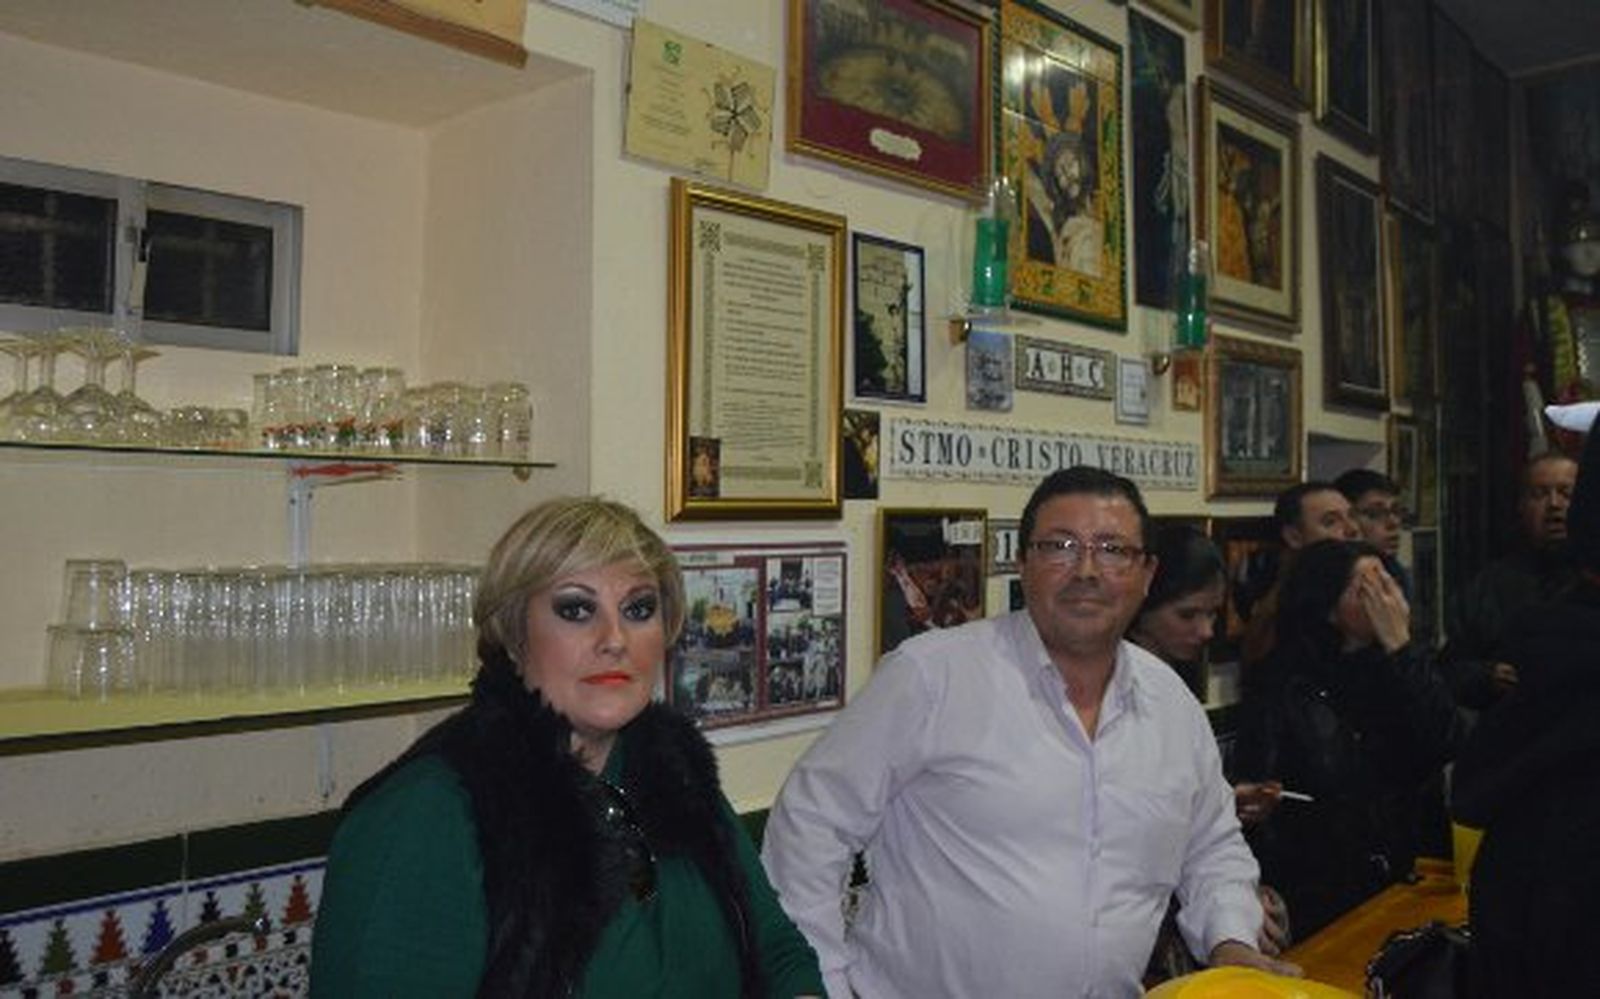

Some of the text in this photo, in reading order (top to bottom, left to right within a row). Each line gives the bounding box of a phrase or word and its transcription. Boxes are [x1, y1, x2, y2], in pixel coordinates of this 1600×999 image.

[900, 429, 1195, 478] STMO CRISTO VERACRUZ
